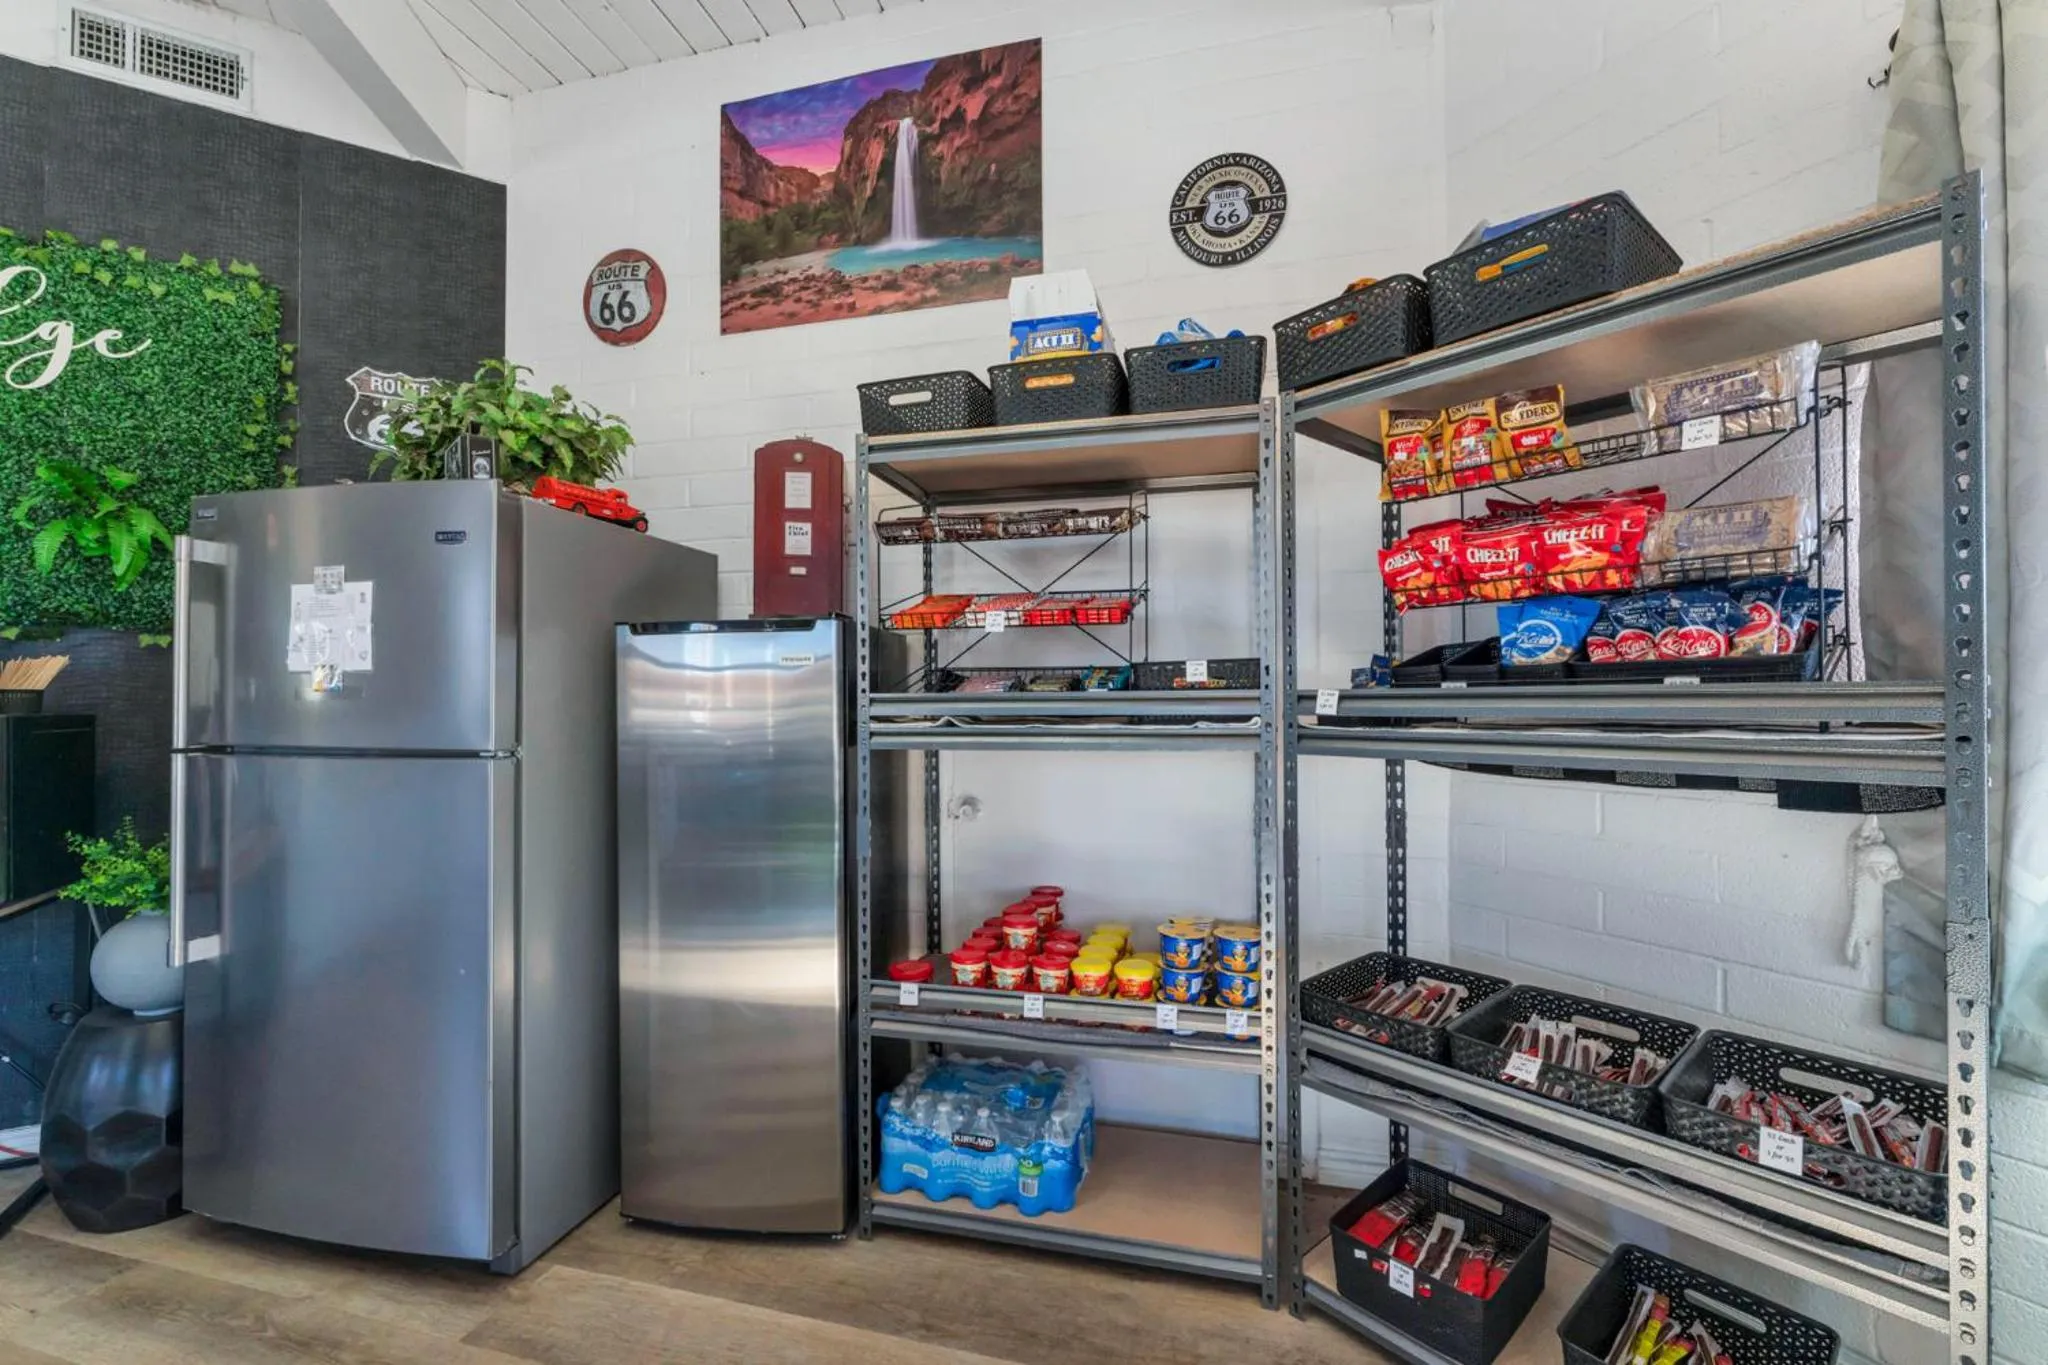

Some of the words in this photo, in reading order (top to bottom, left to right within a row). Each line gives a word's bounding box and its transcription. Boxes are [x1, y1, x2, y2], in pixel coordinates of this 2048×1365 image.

[1174, 156, 1235, 205] CALIFORNIA
[1239, 156, 1281, 191] ARIZONA
[1204, 169, 1241, 183] MEXICO
[1214, 190, 1240, 201] ROUTE
[1172, 209, 1198, 223] EST.
[1258, 198, 1285, 211] 1926
[1213, 208, 1240, 226] 66
[1175, 230, 1223, 264] MISSOURI
[1236, 217, 1280, 262] ILLINOIS
[597, 264, 640, 281] ROUTE
[607, 282, 623, 291] US
[599, 290, 637, 326] 66
[1503, 402, 1558, 424] SYDER'S
[953, 1134, 995, 1149] KIRKLAND
